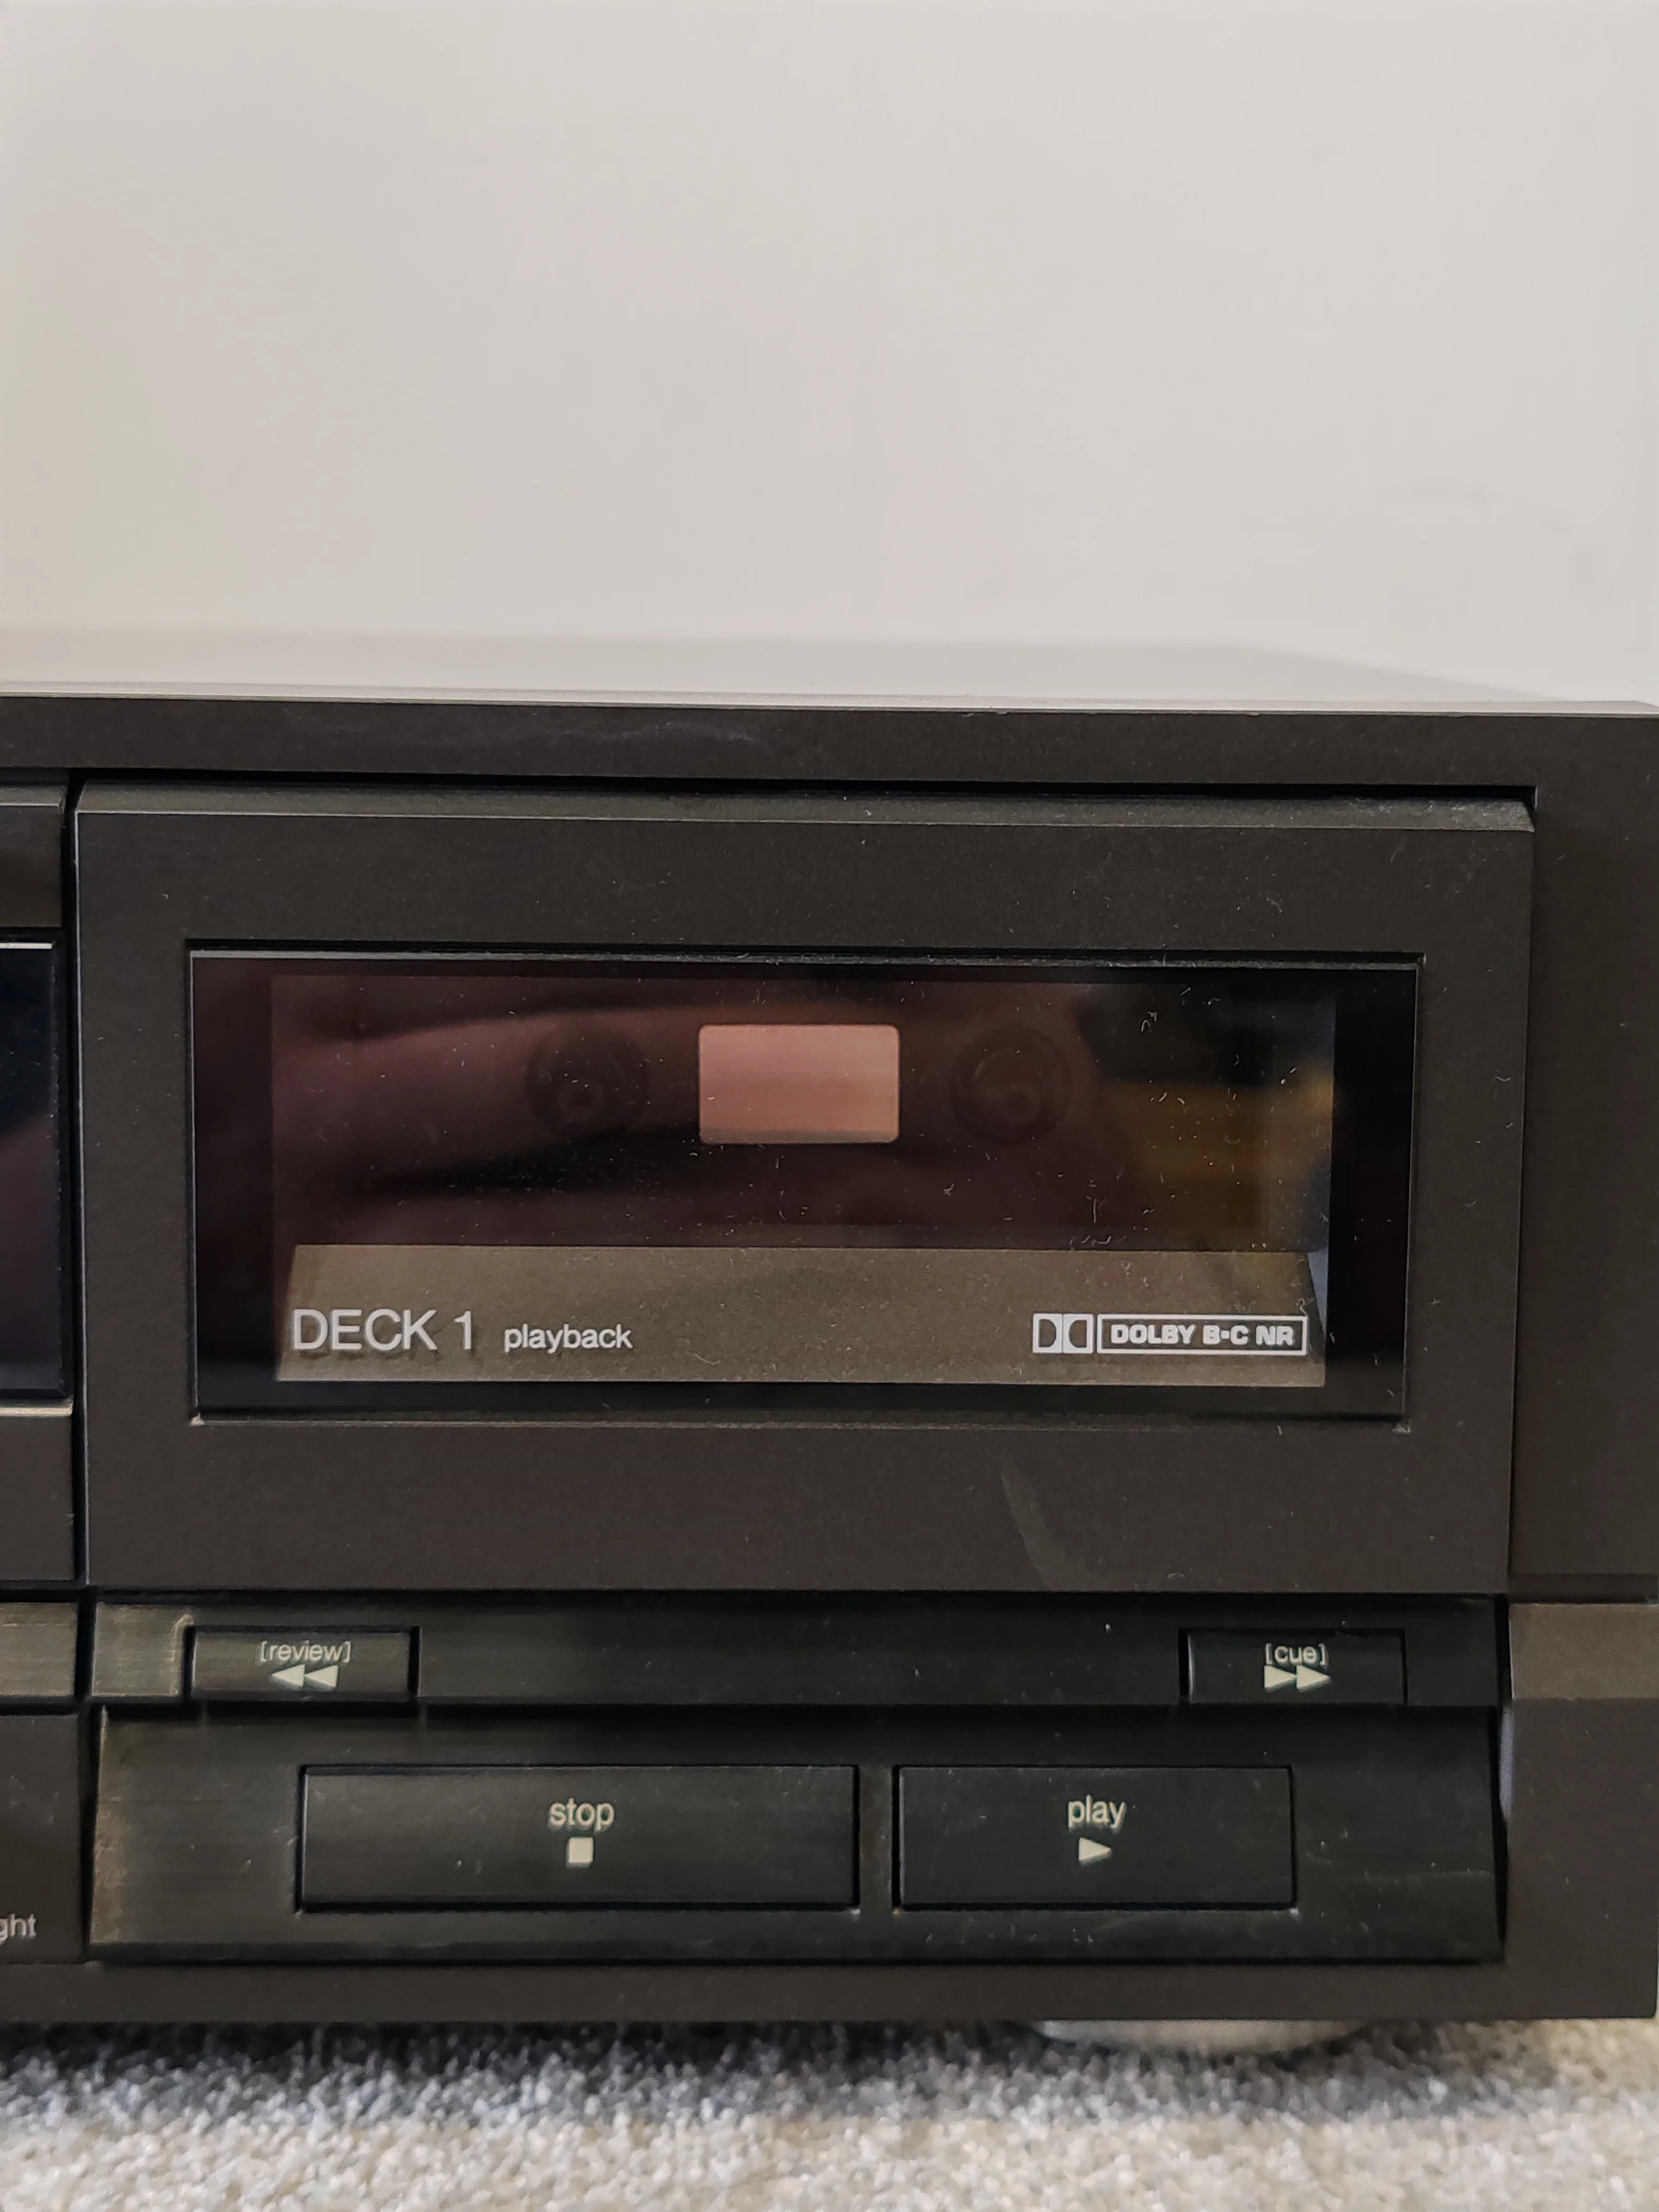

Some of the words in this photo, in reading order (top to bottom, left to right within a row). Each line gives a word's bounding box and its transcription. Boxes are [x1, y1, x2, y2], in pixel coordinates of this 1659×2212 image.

[293, 1308, 438, 1350] DECK
[454, 1310, 473, 1350] 1
[503, 1323, 633, 1353] playback
[1111, 1324, 1196, 1344] DOLBY
[1256, 1325, 1294, 1346] NR
[550, 1797, 615, 1831] stop
[1068, 1794, 1126, 1831] play
